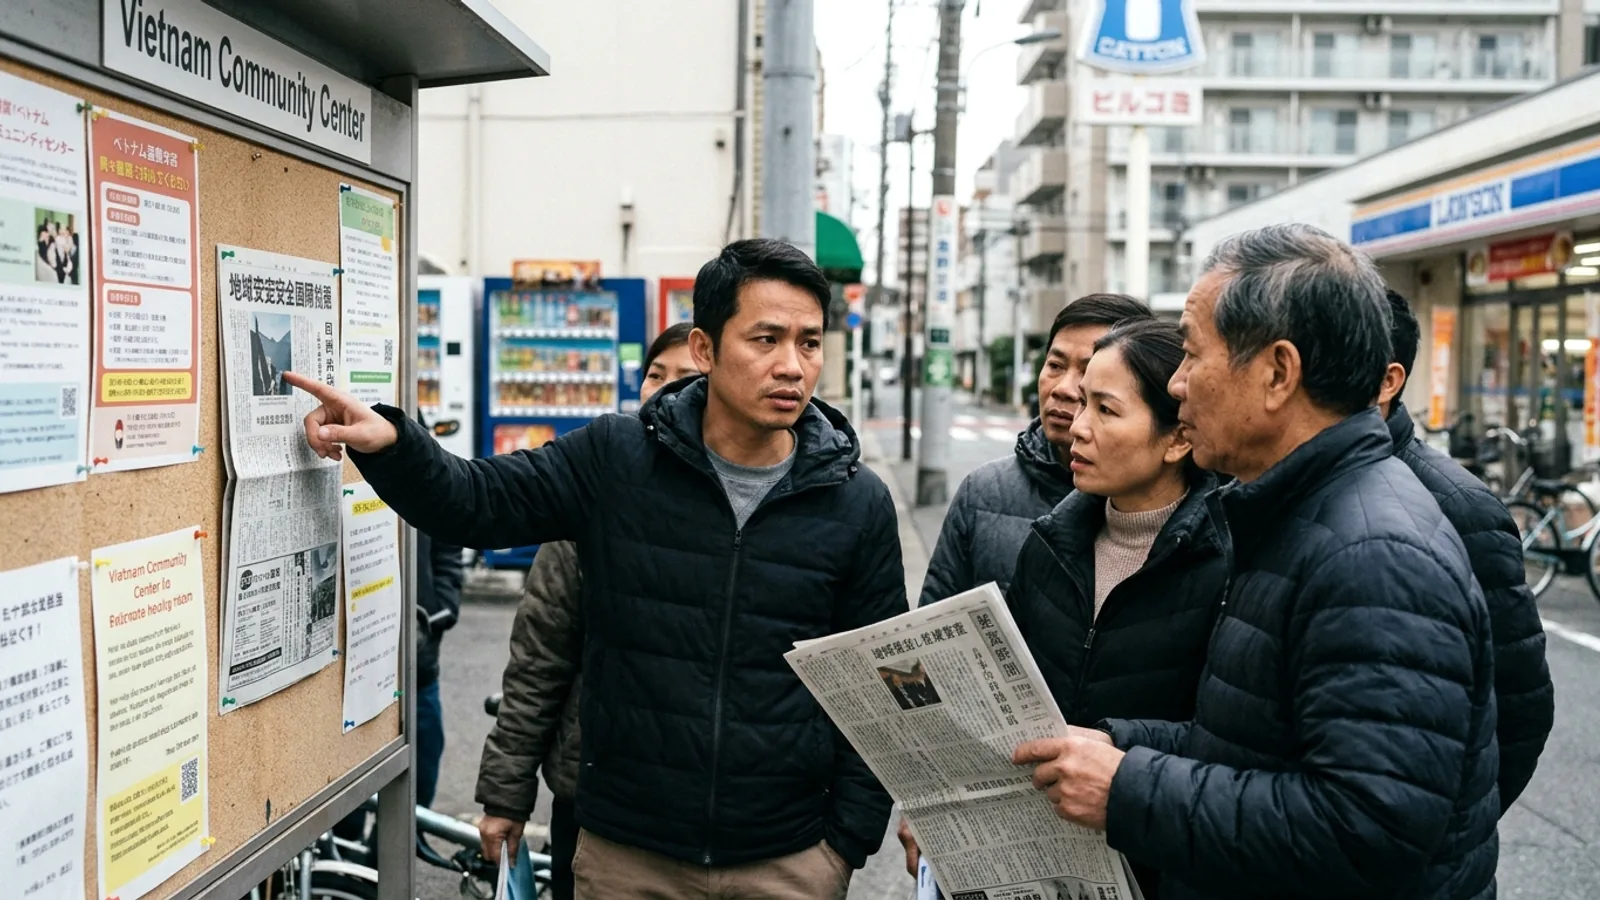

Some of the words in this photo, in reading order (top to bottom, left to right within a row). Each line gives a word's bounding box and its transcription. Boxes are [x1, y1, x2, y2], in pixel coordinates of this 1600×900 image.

[120, 0, 212, 80] Vietnam
[218, 36, 316, 133] Community
[319, 84, 365, 142] Center
